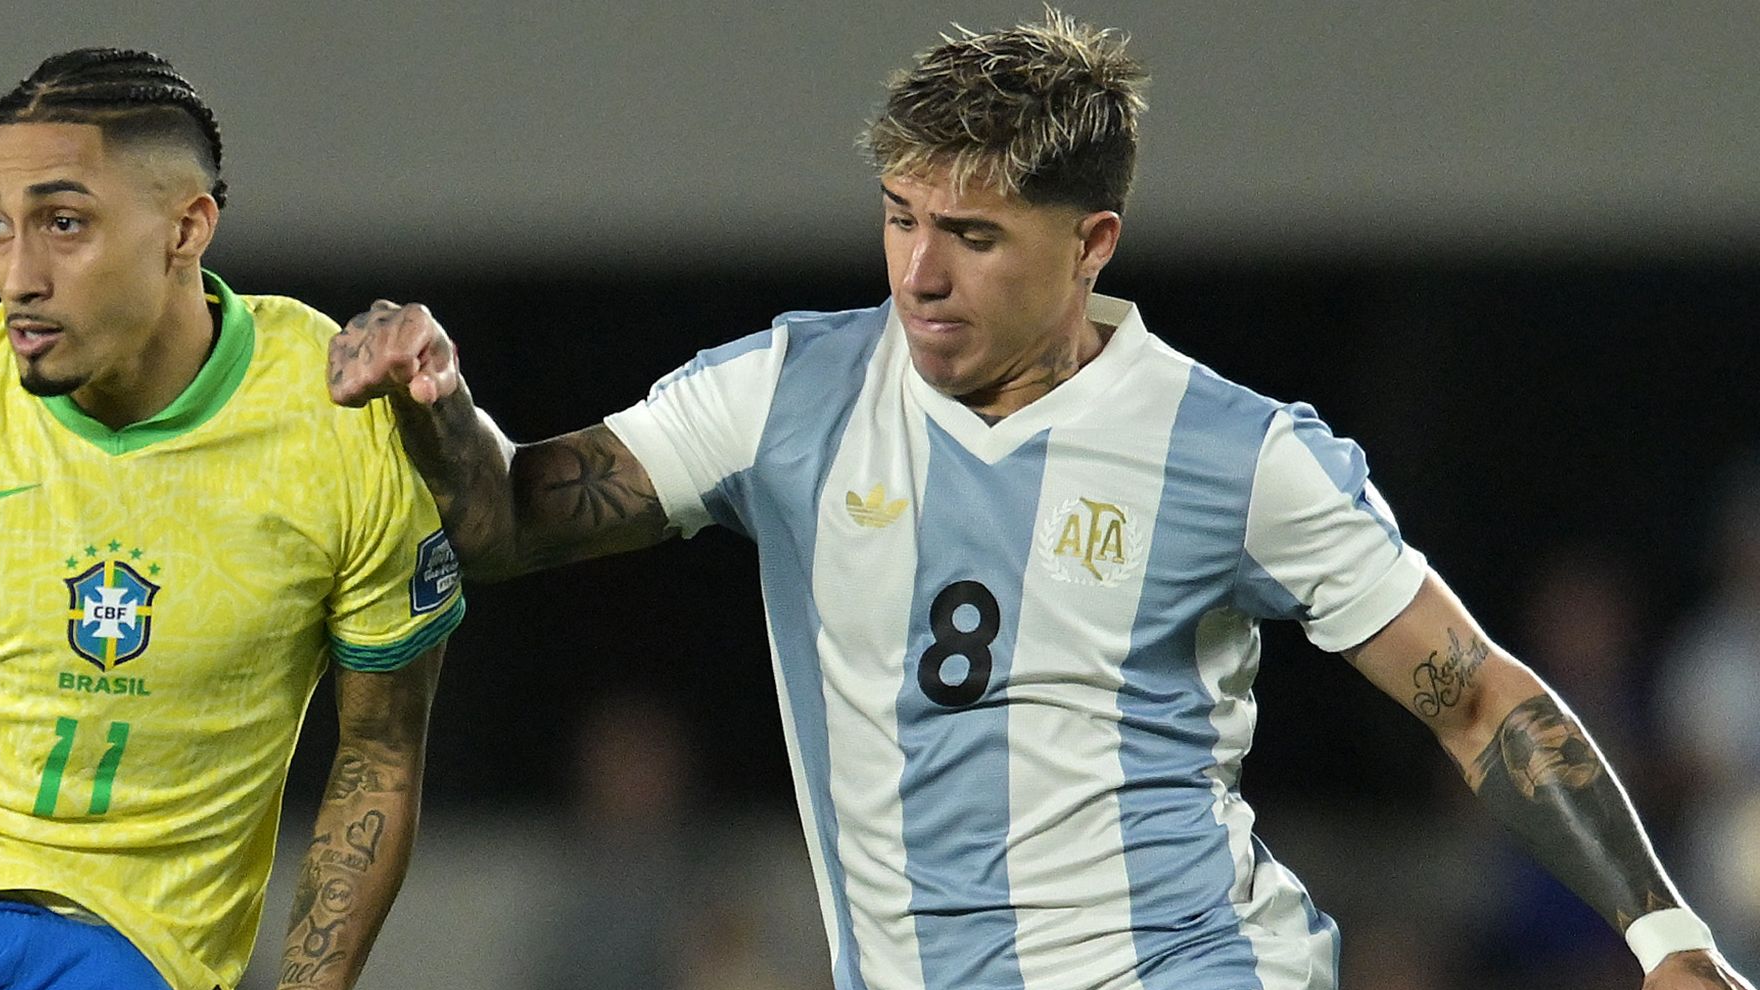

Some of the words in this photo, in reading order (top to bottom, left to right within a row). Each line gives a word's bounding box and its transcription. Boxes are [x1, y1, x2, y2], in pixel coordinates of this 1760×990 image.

[1054, 496, 1127, 581] AFA
[93, 605, 127, 620] CBF
[917, 579, 1000, 708] 8
[58, 672, 152, 696] BRASIL
[33, 716, 129, 817] 11
